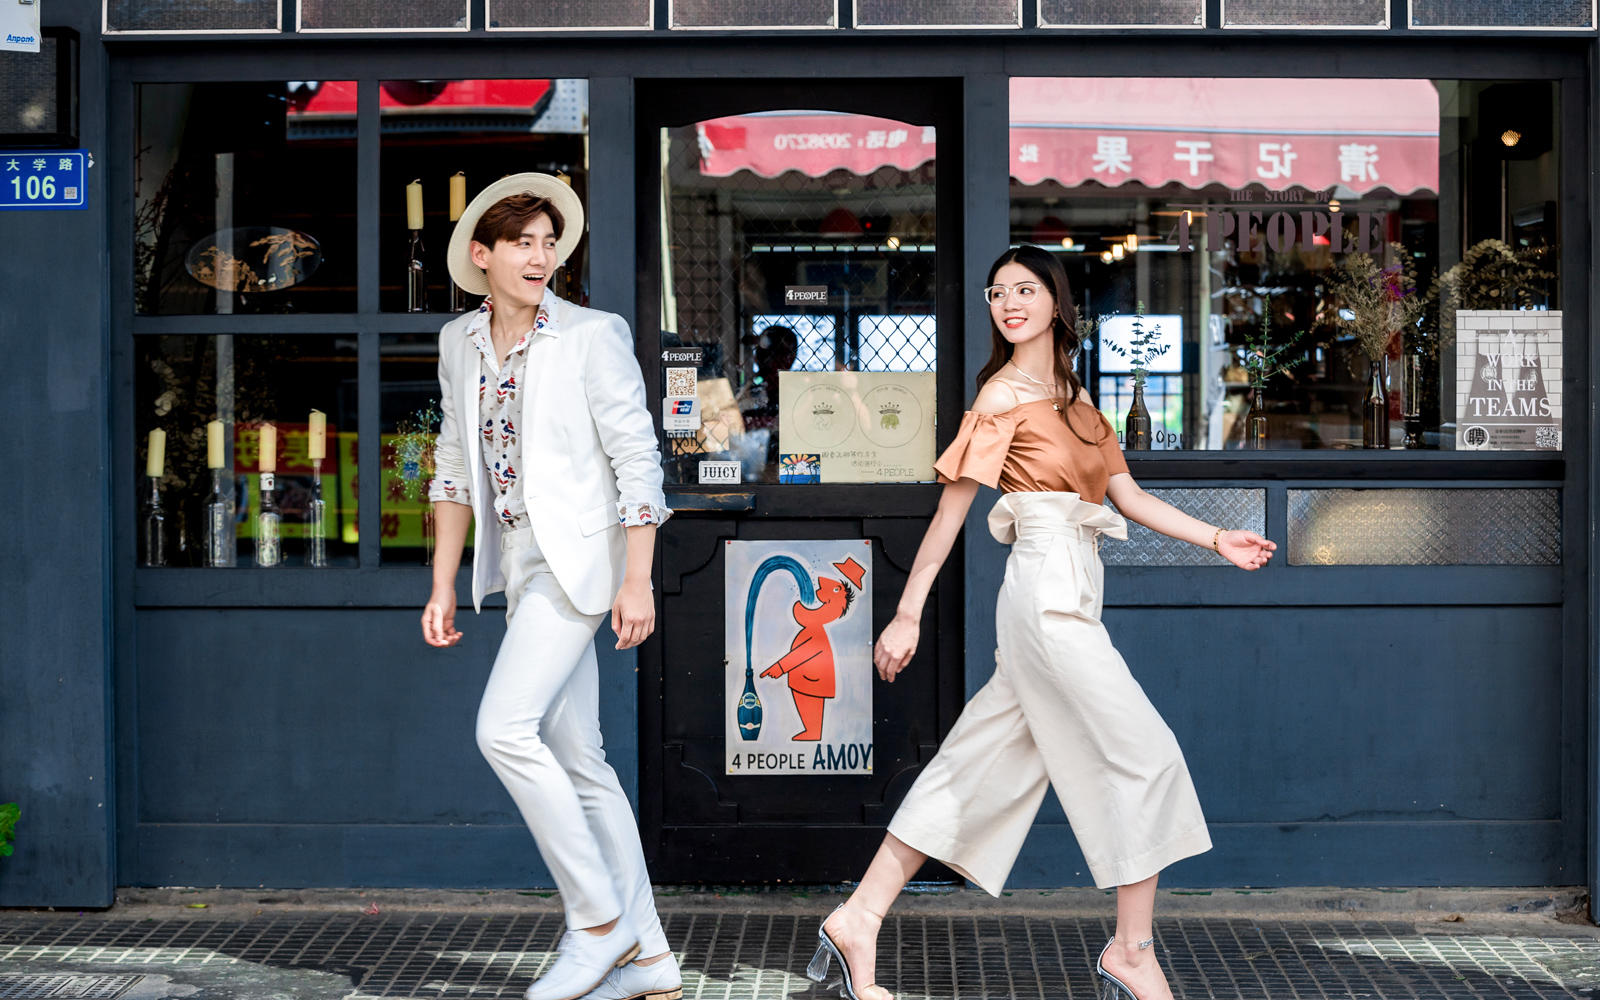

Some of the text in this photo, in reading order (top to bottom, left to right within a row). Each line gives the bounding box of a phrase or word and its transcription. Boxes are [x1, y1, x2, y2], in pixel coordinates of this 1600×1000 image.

[6, 158, 73, 171] 大学路
[11, 175, 56, 200] 106
[1230, 190, 1331, 202] THE STORY OF
[1166, 211, 1386, 252] 4 PEOPLE
[1487, 379, 1502, 391] IN
[1469, 397, 1552, 417] TEAMS
[702, 466, 738, 479] JUICY
[732, 743, 873, 770] 4 PEOPLE AMOY
